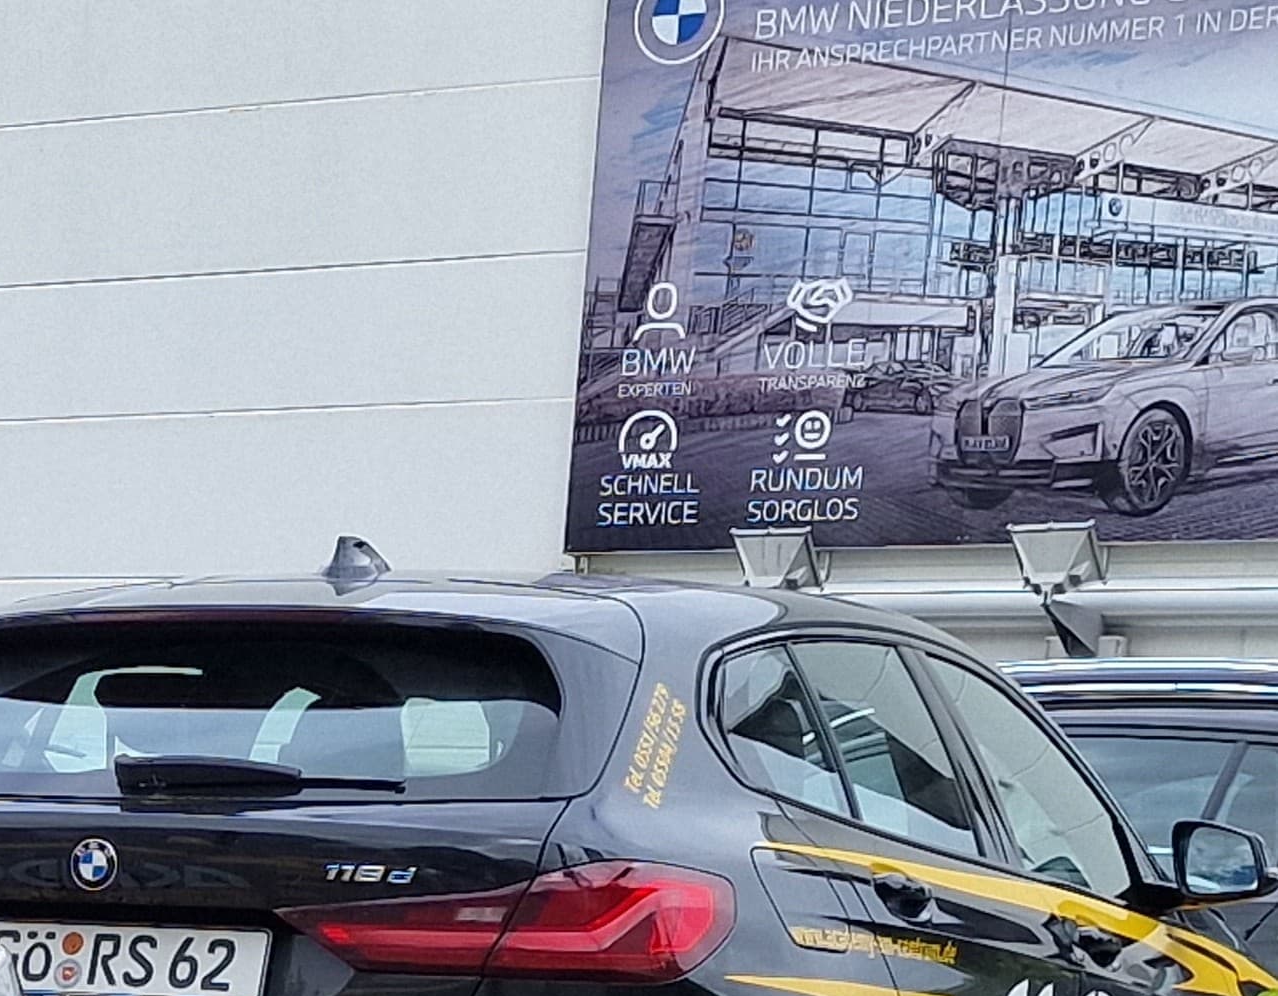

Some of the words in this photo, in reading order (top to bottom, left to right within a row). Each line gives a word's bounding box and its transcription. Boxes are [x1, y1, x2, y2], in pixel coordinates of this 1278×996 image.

[755, 2, 839, 40] BMW
[849, 0, 1150, 30] NIEDERLA
[751, 50, 791, 73] IHR
[795, 27, 1042, 69] ANSPRECHPARTNER
[1049, 16, 1164, 46] NUMMER
[1174, 13, 1185, 36] 1
[1196, 10, 1222, 33] IN
[1229, 5, 1278, 31] DER
[621, 345, 696, 377] BMW
[764, 338, 867, 369] VOLLE
[617, 381, 692, 398] EXPERTEN
[758, 373, 866, 392] TRANSPARENZ
[620, 452, 672, 469] VMAX
[599, 472, 700, 496] SCHNELL
[749, 466, 863, 492] RUNDUM
[596, 501, 699, 526] SERVICE
[746, 498, 860, 522] SORGLOS
[325, 863, 418, 884] 118d
[87, 933, 158, 988] RS
[168, 937, 236, 992] 62
